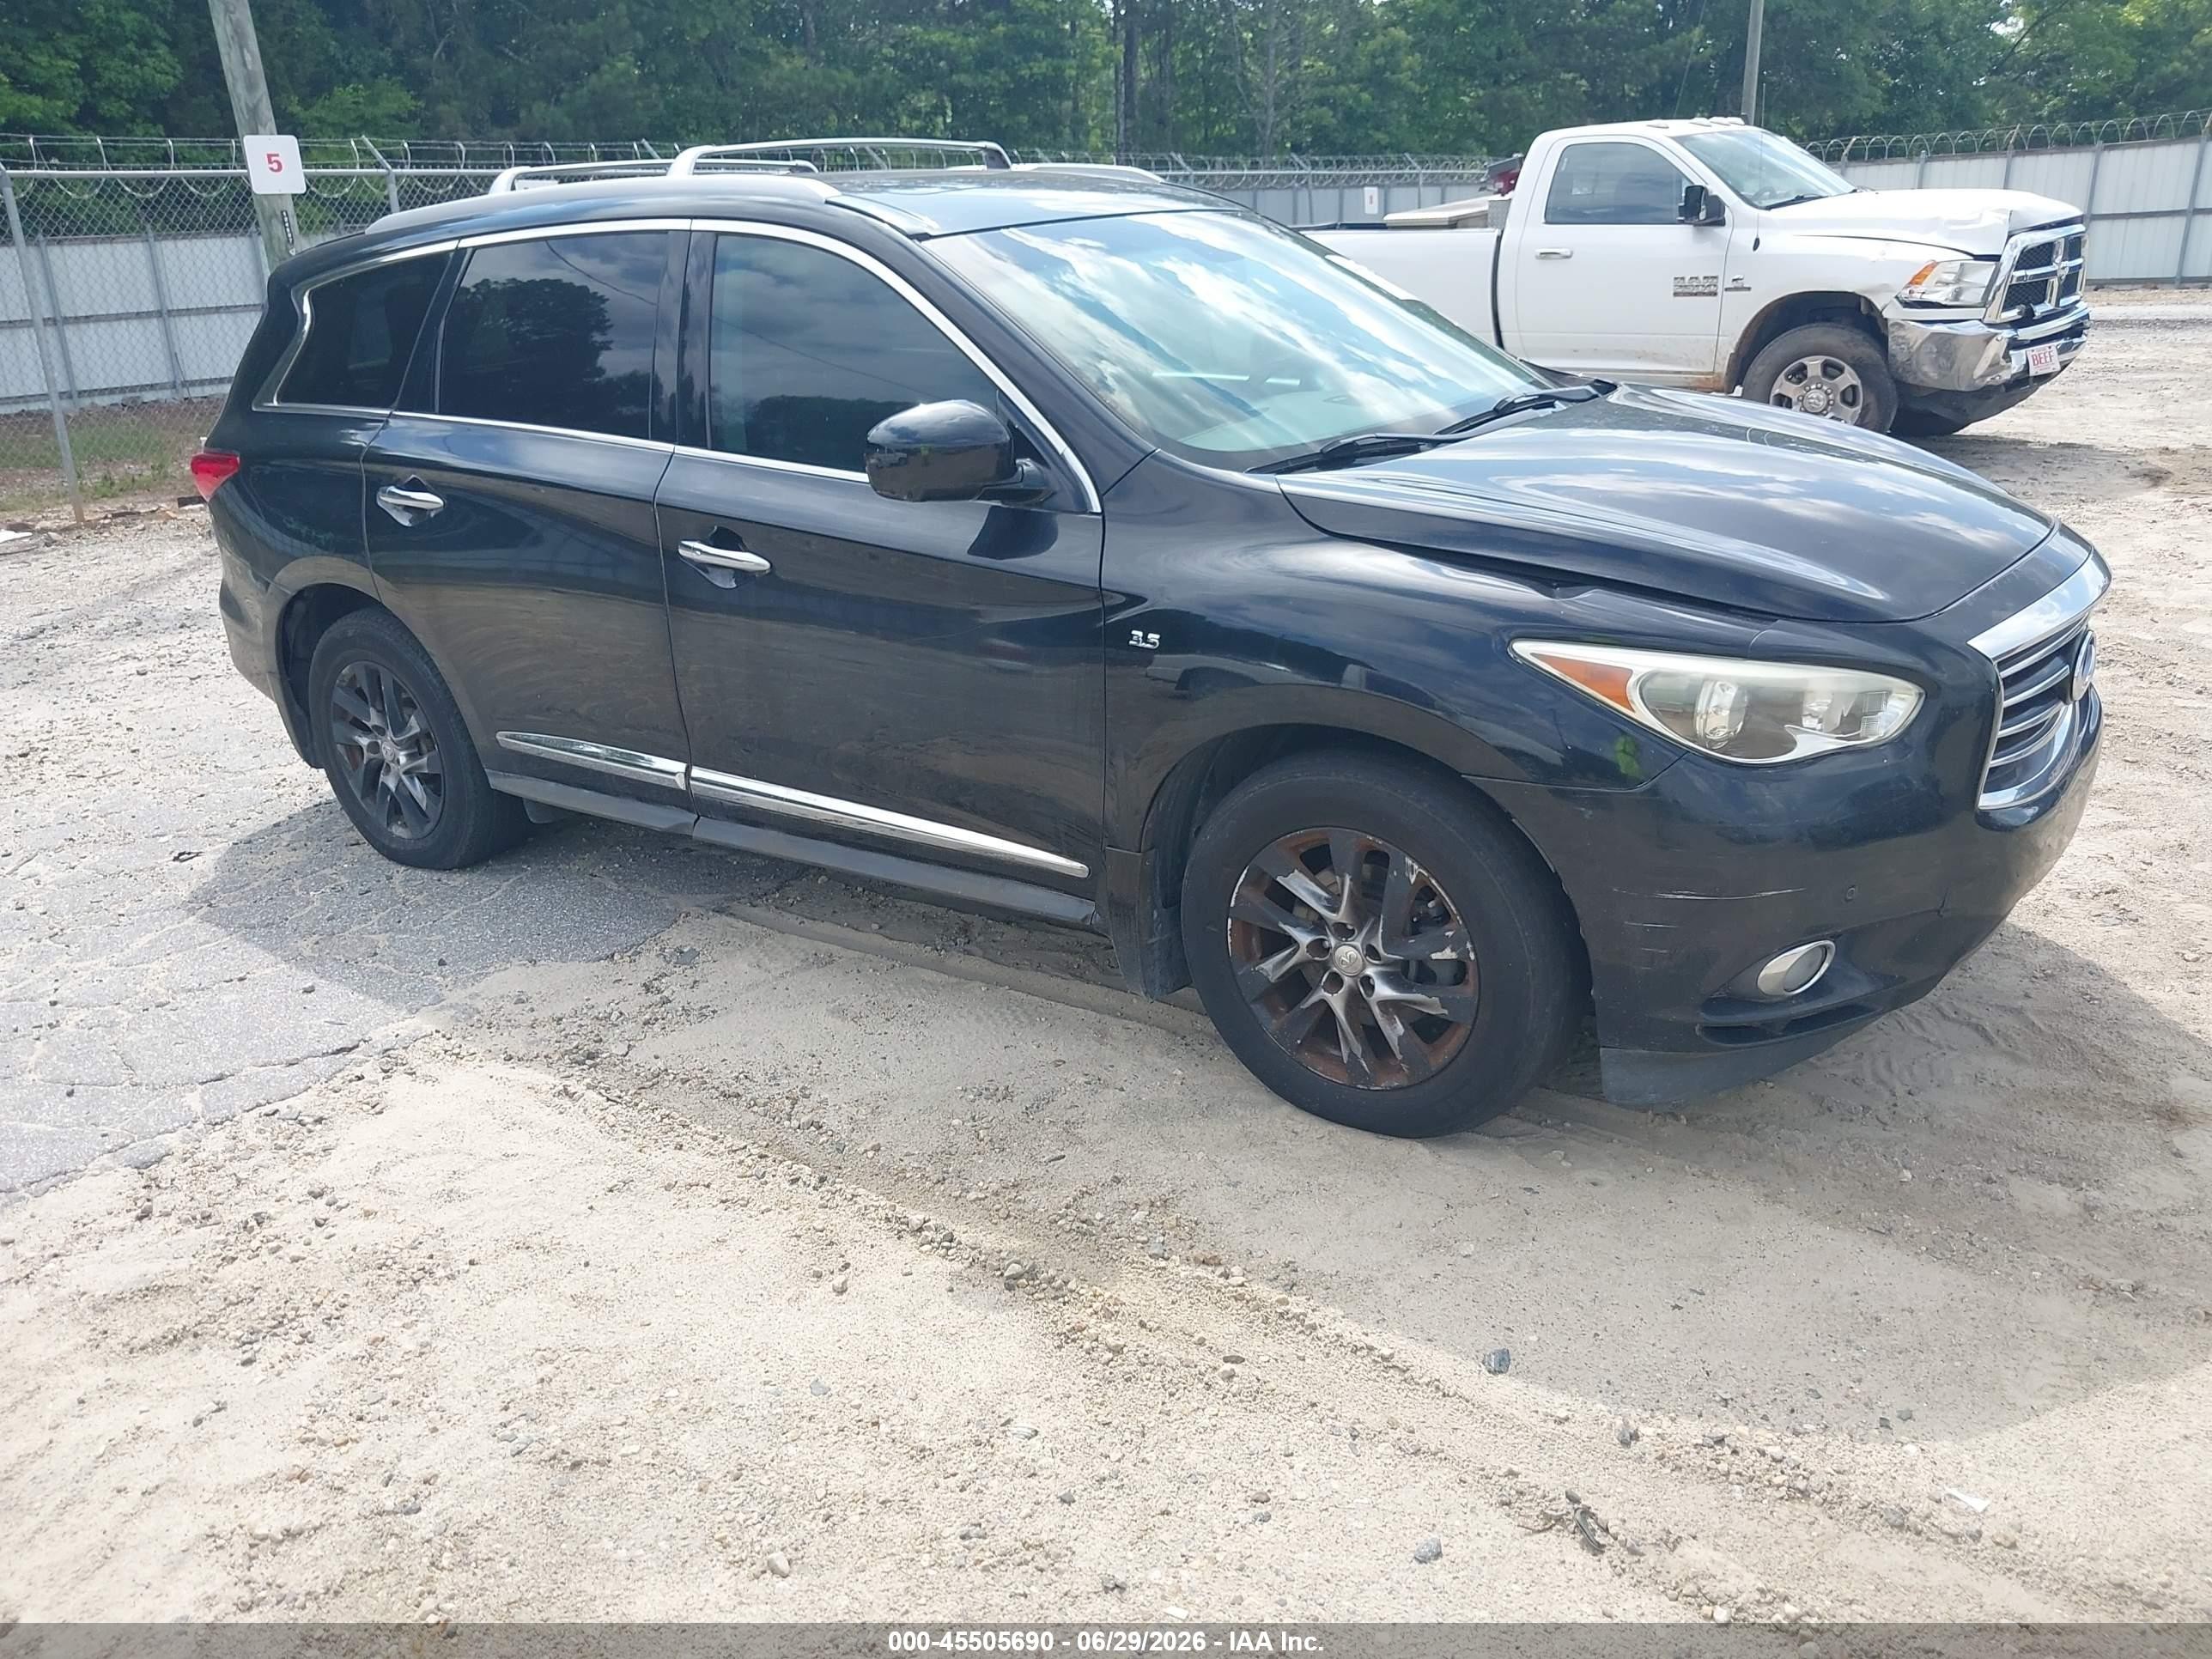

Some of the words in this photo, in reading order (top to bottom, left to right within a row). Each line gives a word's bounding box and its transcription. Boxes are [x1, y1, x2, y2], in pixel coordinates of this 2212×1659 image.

[266, 153, 283, 173] 5
[2031, 350, 2054, 367] BEEF
[1128, 629, 1160, 649] 3.5
